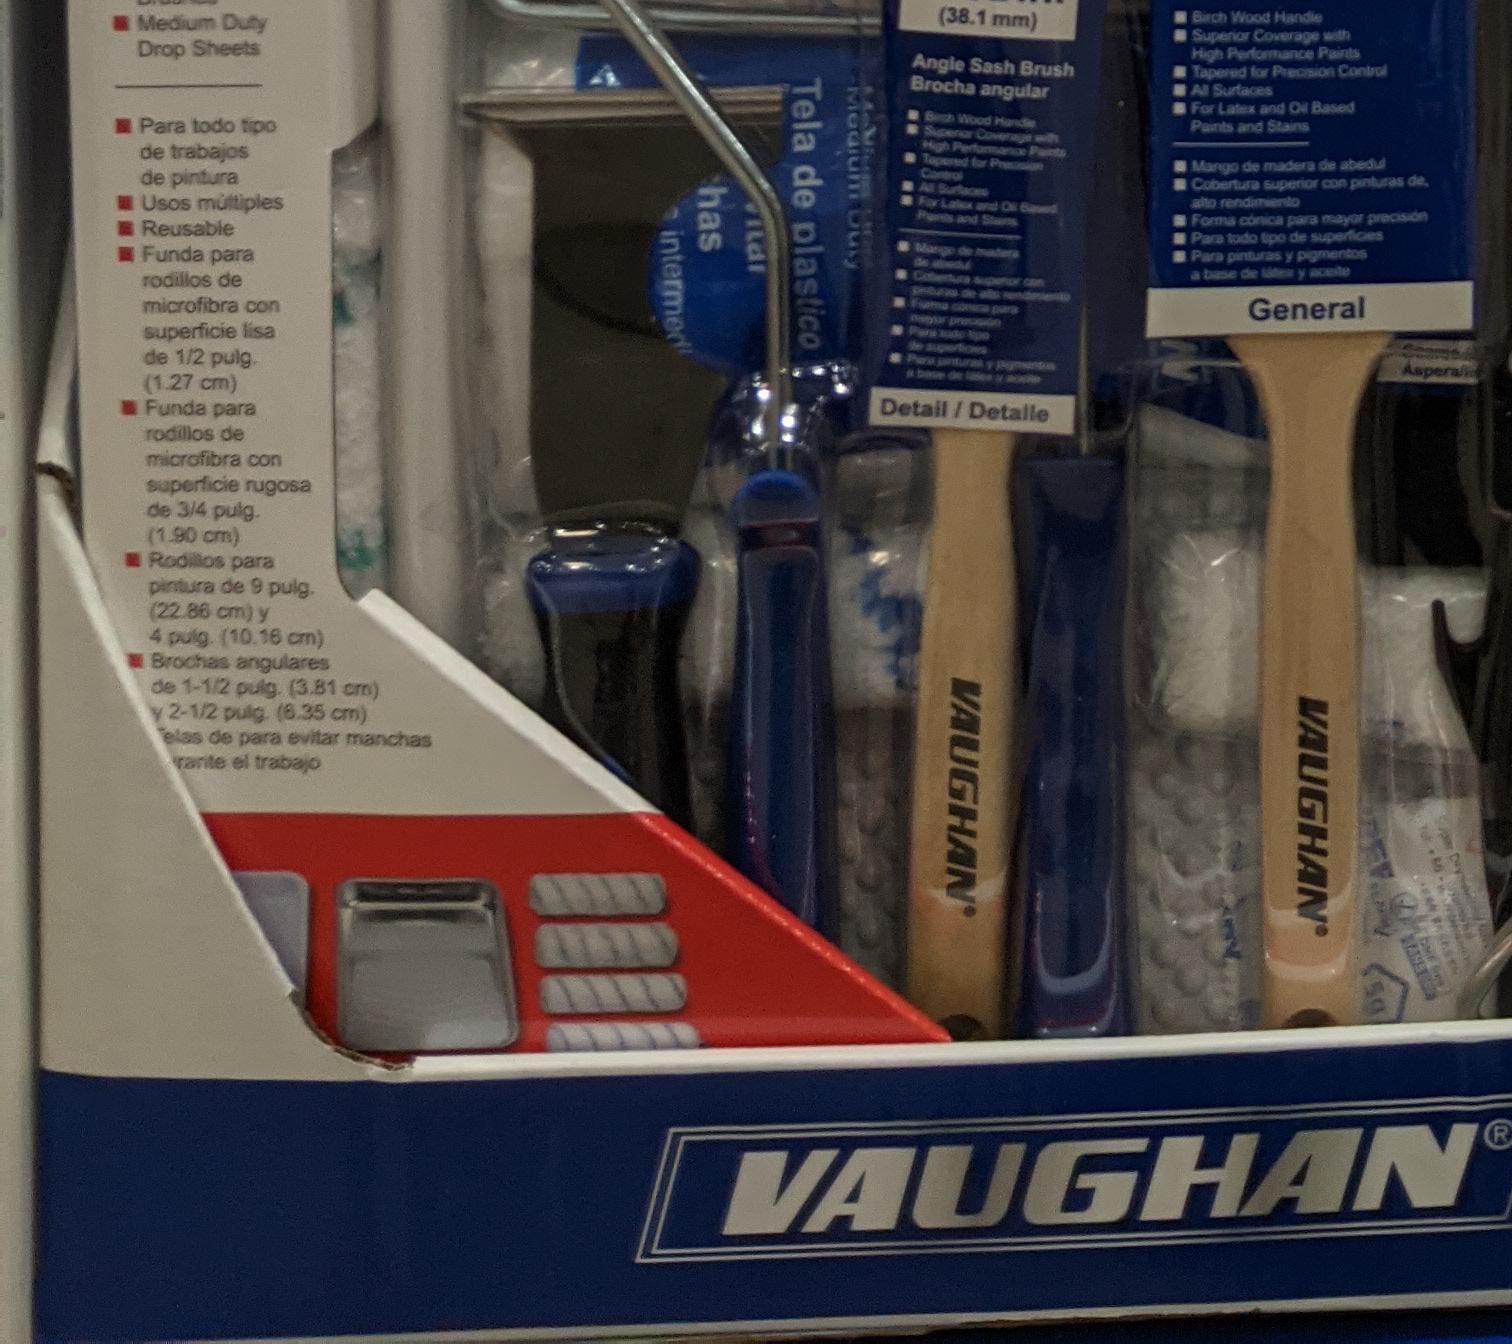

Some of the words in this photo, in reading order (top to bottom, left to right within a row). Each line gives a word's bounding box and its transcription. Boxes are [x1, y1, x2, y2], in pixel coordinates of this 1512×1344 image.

[137, 15, 216, 31] Medium
[222, 14, 267, 34] Duty
[939, 6, 987, 27] (38.1
[991, 10, 1038, 32] mm)
[138, 40, 185, 60] Drop
[192, 39, 261, 57] Sheets
[912, 52, 965, 75] Angle
[970, 57, 1015, 77] Sash
[1020, 60, 1074, 79] Brush
[910, 74, 976, 96] Brocha
[980, 80, 1049, 102] angular
[140, 118, 186, 134] Para
[192, 118, 235, 134] todo
[242, 118, 277, 137] tipo
[171, 143, 249, 163] trabajos
[142, 195, 191, 211] Usos
[142, 220, 235, 237] Reusable
[1248, 295, 1366, 323] General
[880, 398, 948, 418] Detail
[968, 401, 1049, 424] Detalle
[236, 653, 329, 674] angulares
[346, 730, 432, 749] manchas
